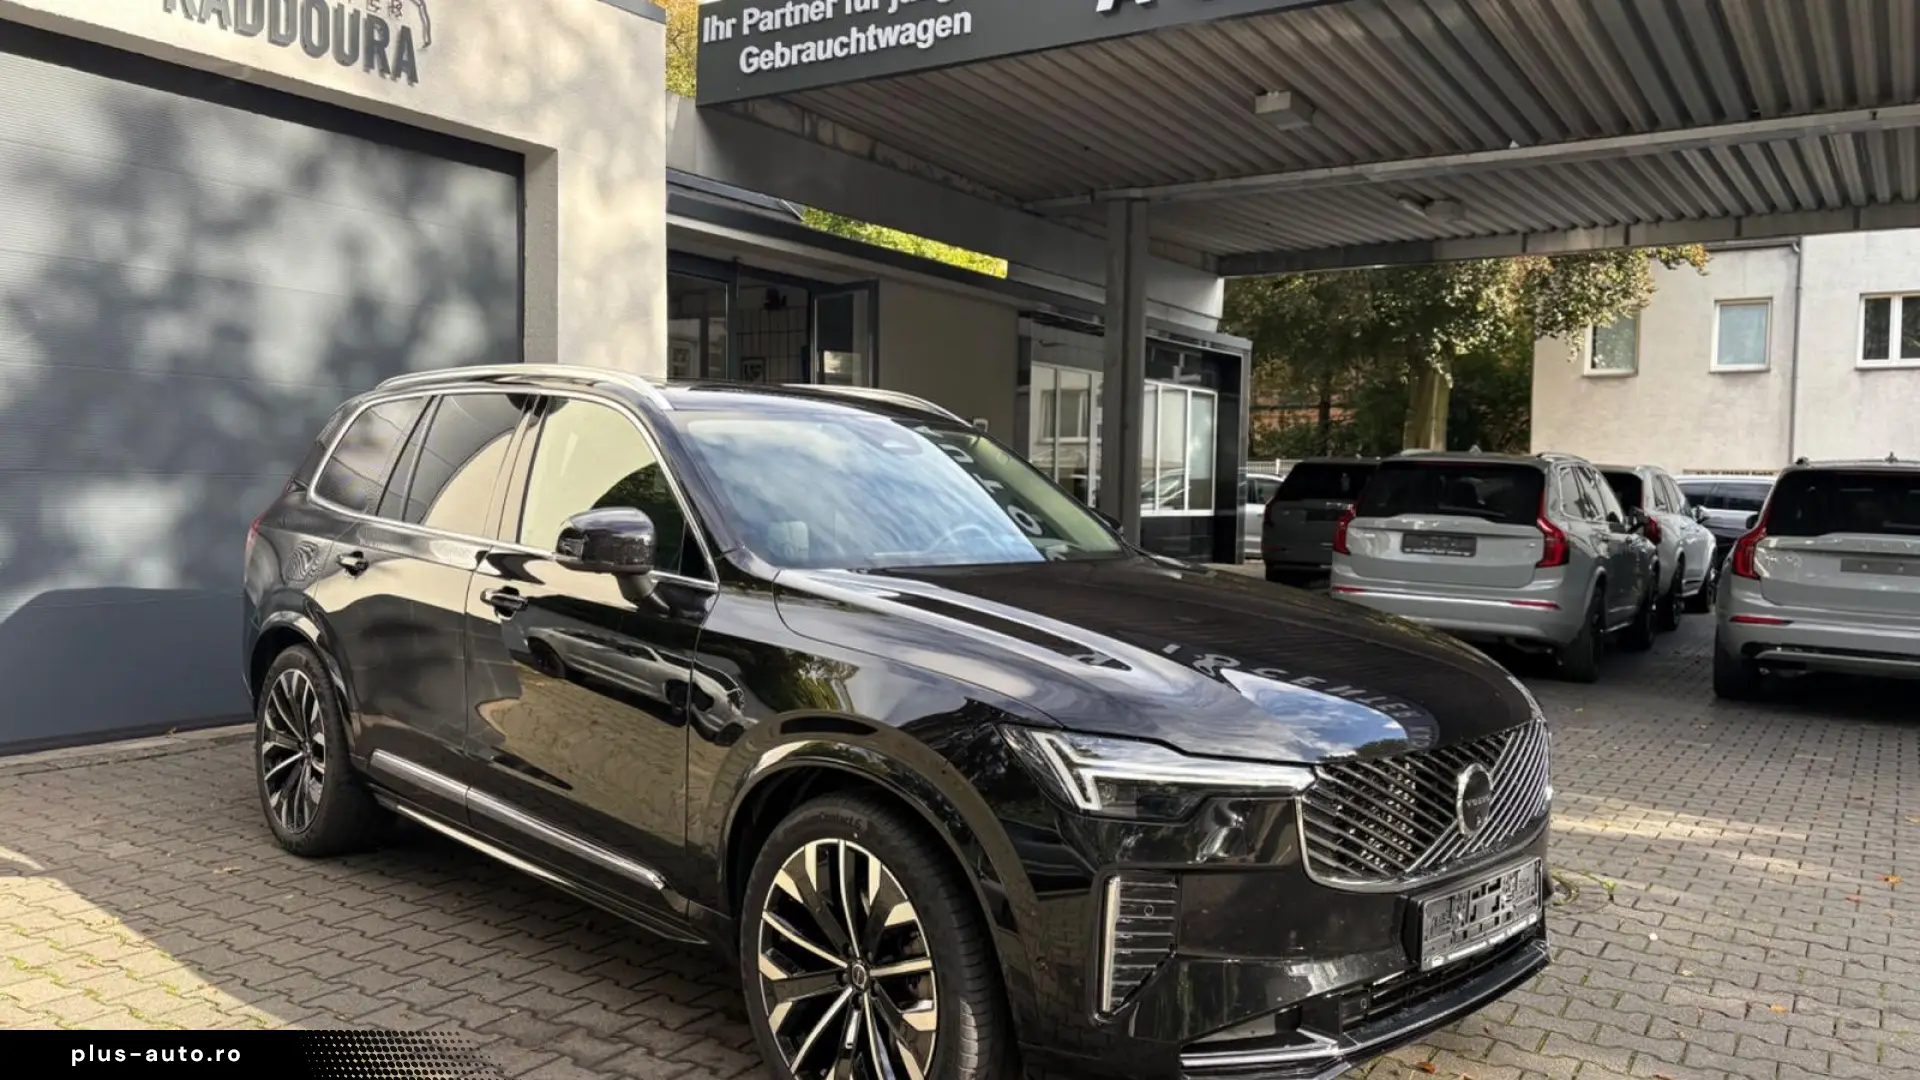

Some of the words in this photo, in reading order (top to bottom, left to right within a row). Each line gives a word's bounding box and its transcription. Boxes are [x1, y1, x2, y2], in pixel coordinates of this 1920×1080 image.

[703, 16, 737, 43] Ihr
[742, 0, 838, 35] Partner
[739, 11, 971, 74] Gebrauchtwagen
